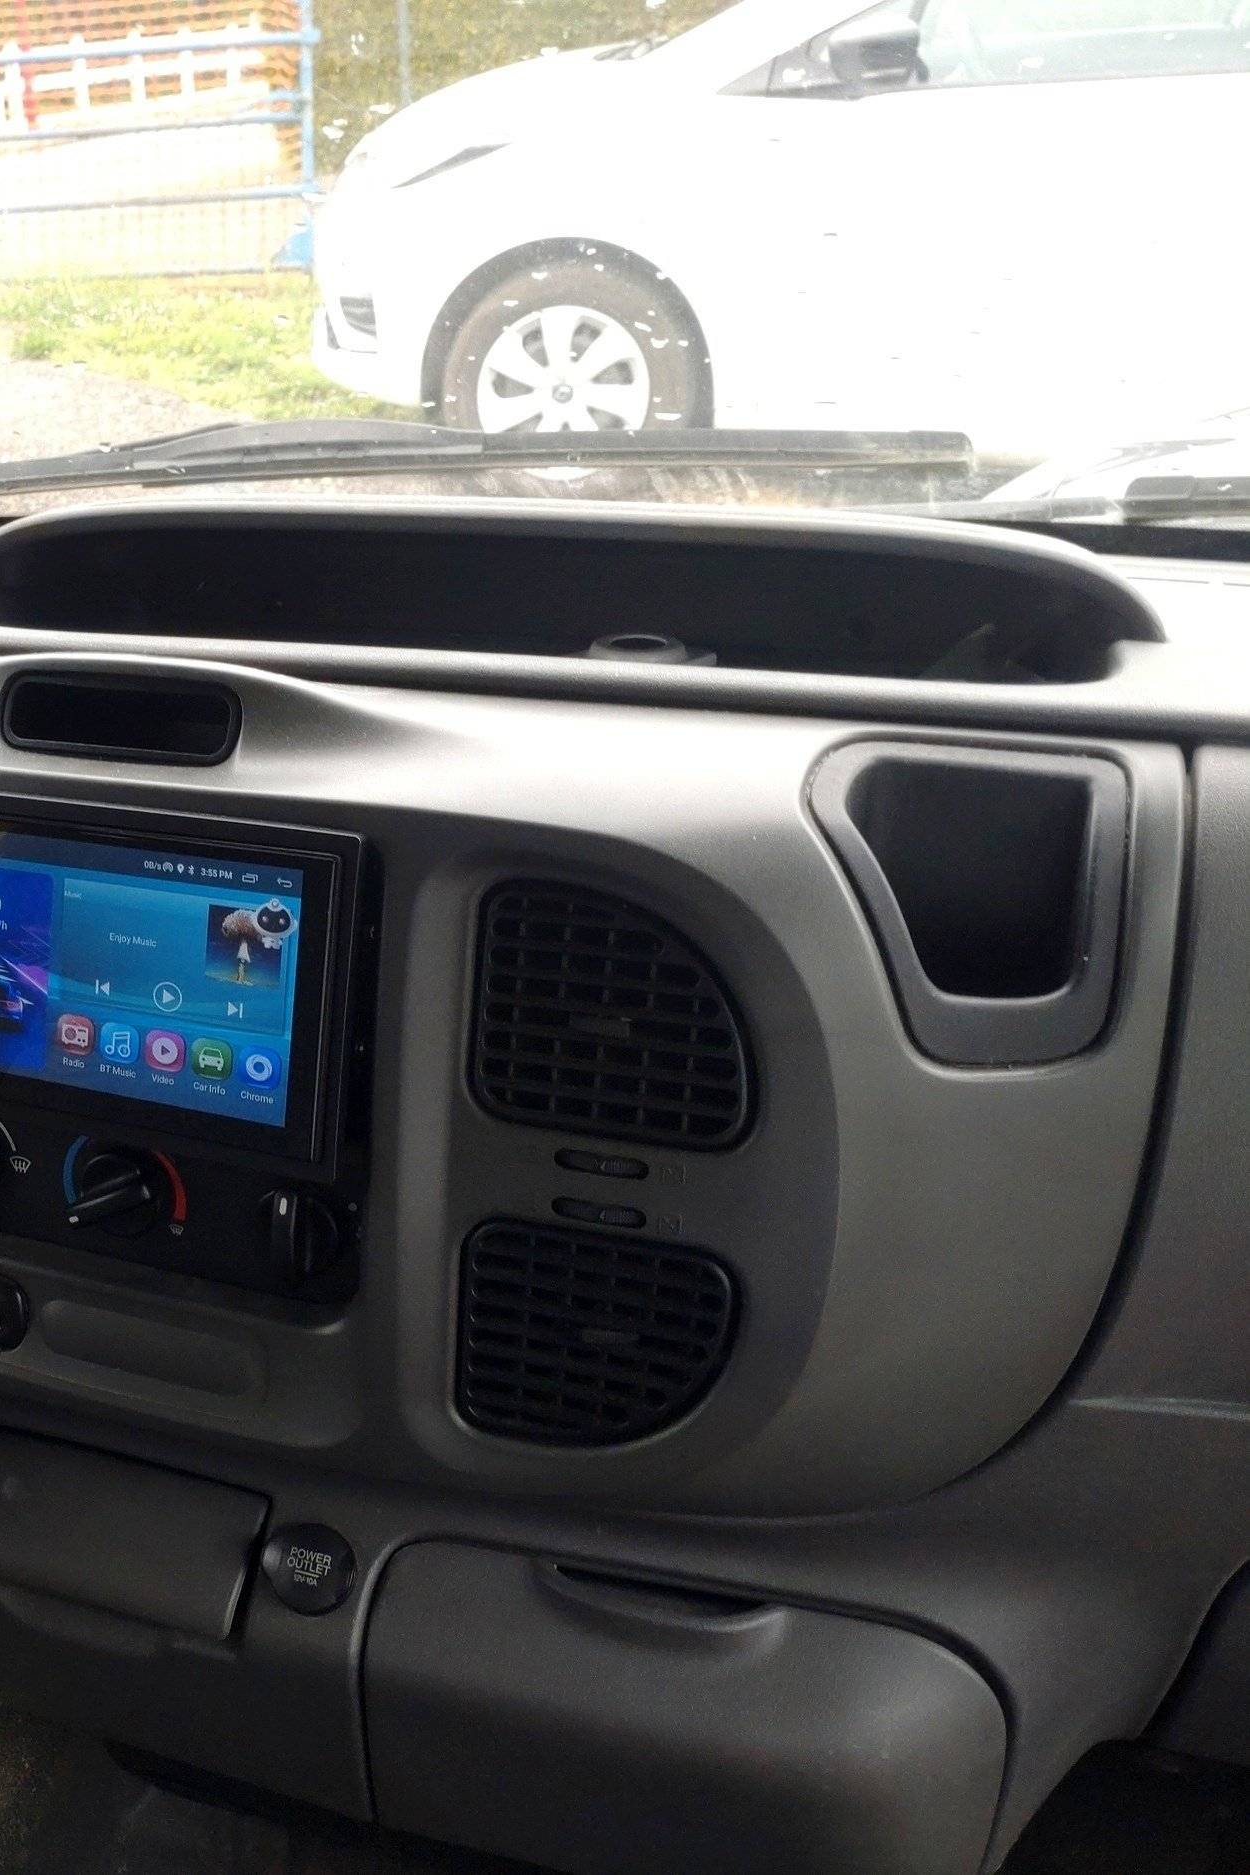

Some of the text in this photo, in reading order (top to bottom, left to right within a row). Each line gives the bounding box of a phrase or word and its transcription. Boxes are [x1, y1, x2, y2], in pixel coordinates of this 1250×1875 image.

[219, 870, 233, 880] PM
[109, 932, 157, 948] Enjoy Music
[62, 1056, 85, 1069] Radio
[100, 1064, 136, 1079] BT Music
[151, 1073, 175, 1086] Video
[193, 1081, 226, 1096] Car Info
[240, 1090, 274, 1105] Chrome
[290, 1546, 332, 1567] POWER
[287, 1556, 331, 1576] OUTLET
